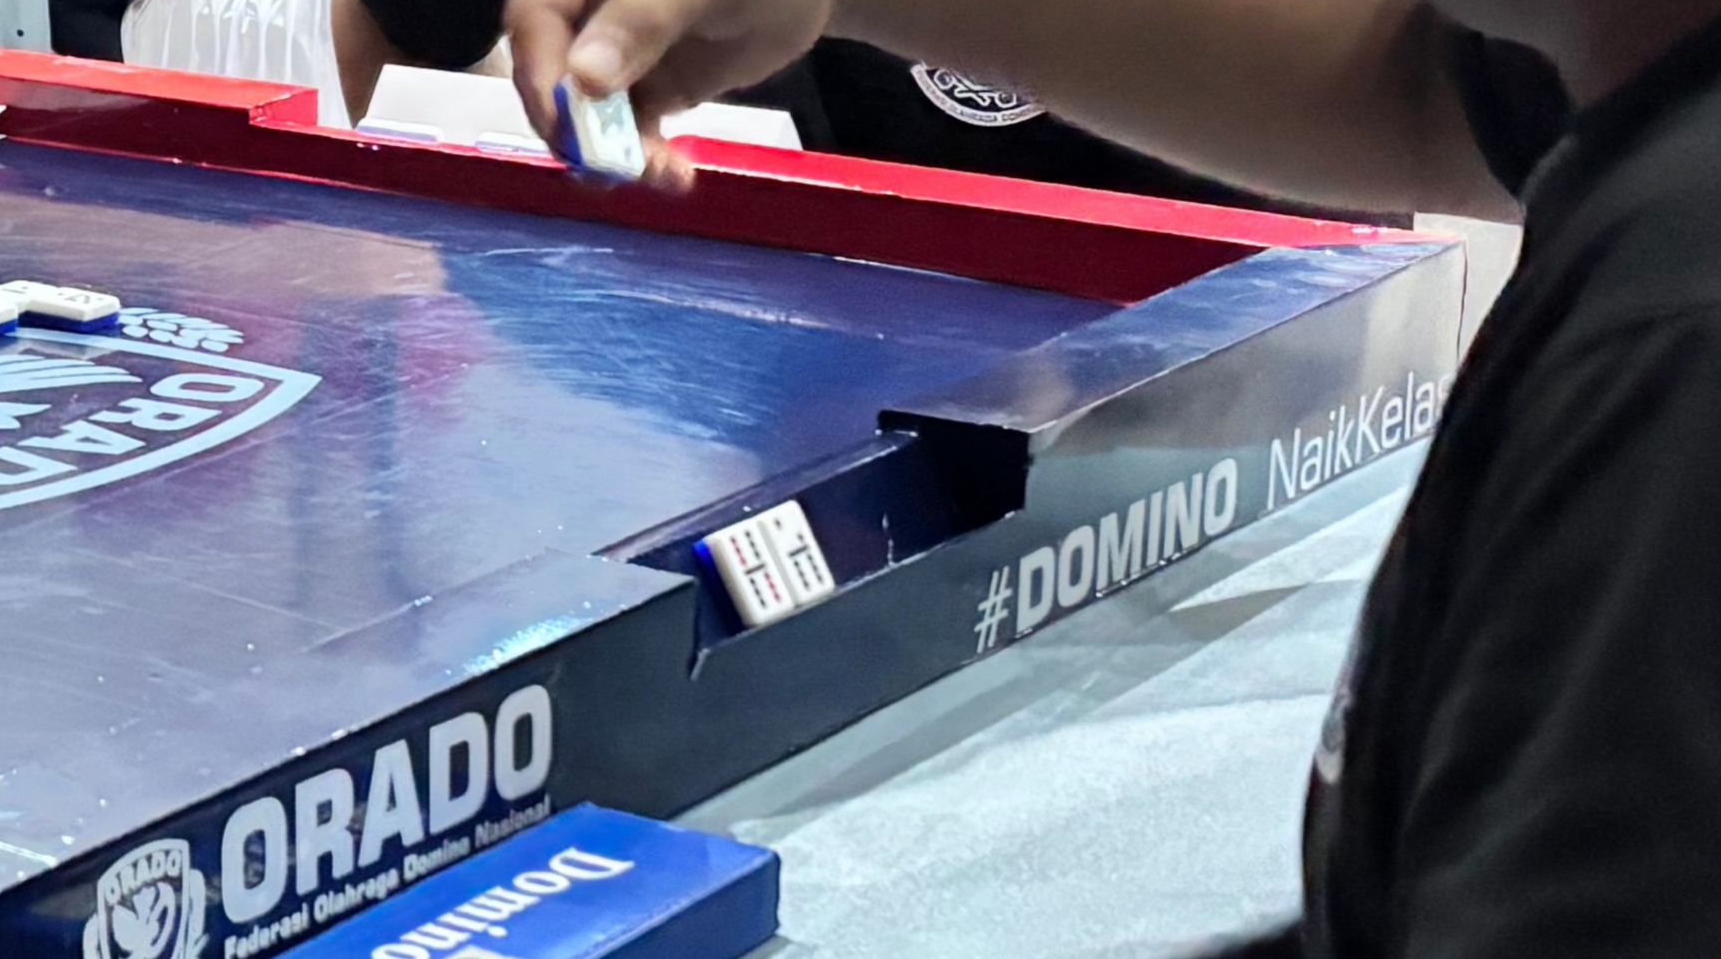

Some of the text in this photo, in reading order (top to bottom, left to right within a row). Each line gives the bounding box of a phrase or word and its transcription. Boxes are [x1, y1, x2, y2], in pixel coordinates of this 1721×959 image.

[974, 457, 1239, 654] #DOMINO
[222, 683, 554, 924] ORADO
[103, 848, 181, 906] ORADO
[223, 903, 310, 959] Federasi
[313, 867, 400, 924] Olahraga
[403, 837, 471, 883] Domino
[371, 846, 636, 959] Domino
